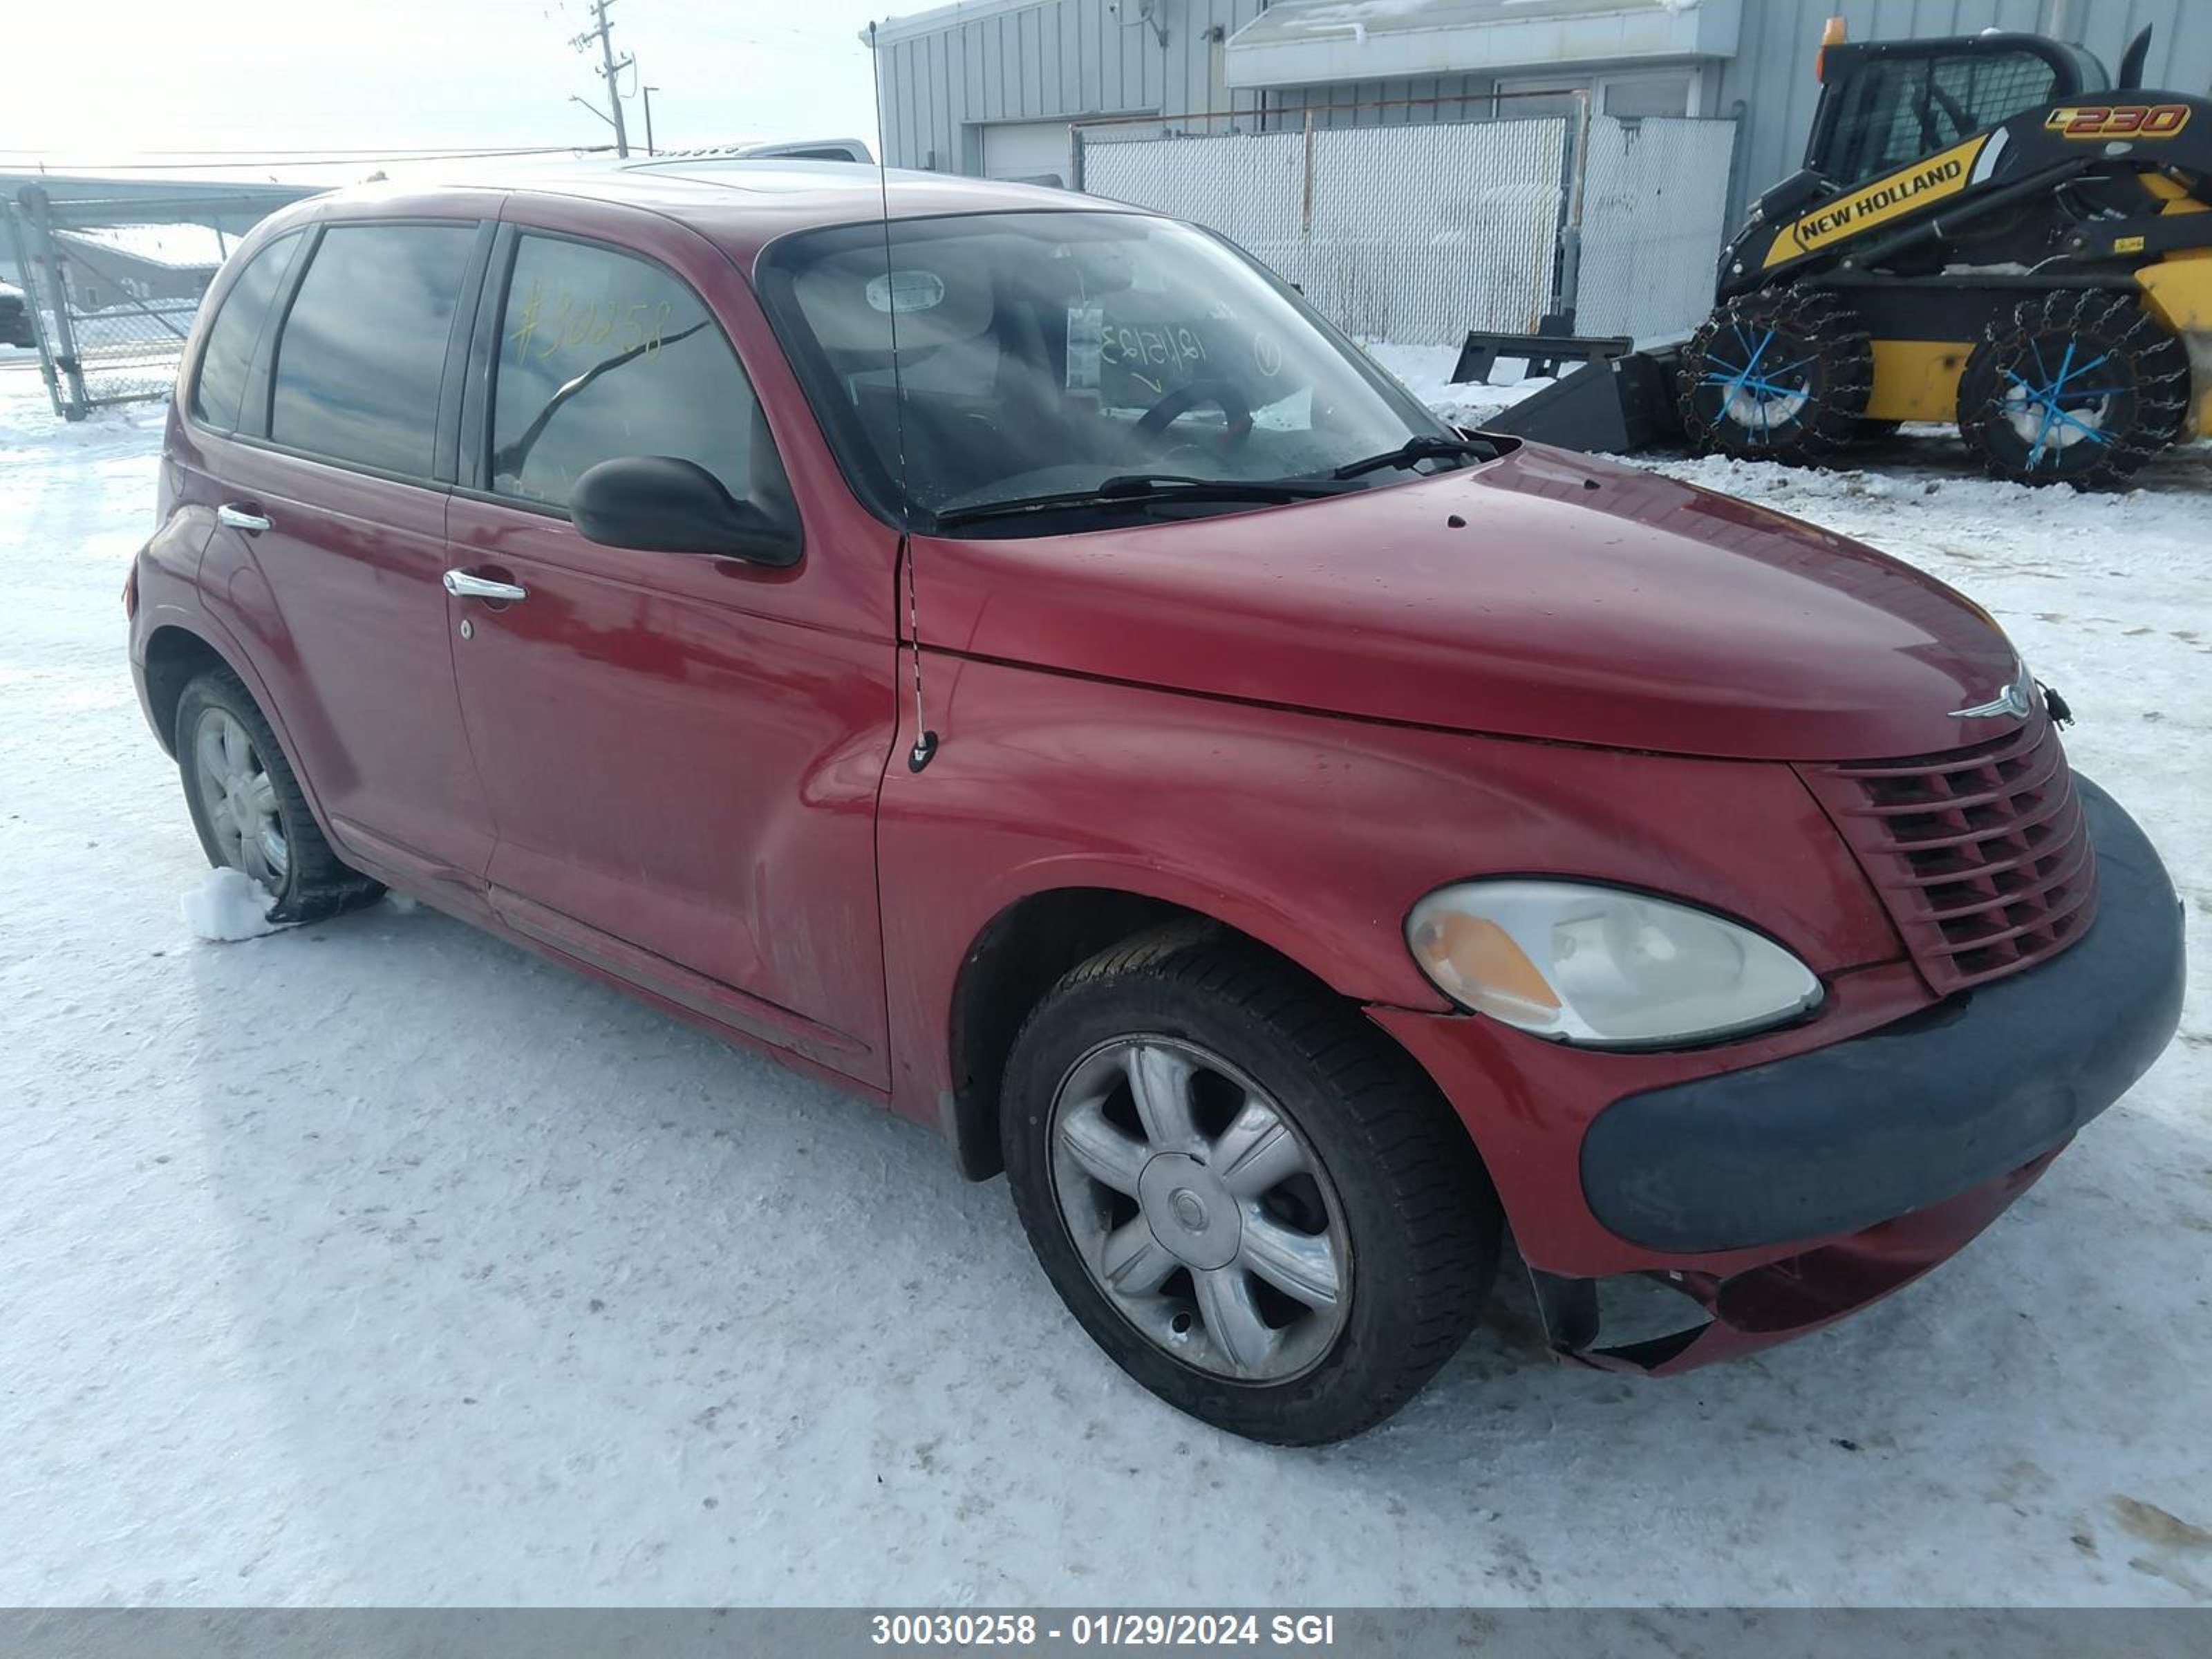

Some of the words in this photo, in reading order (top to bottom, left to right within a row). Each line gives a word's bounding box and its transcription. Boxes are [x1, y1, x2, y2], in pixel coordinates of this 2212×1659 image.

[2048, 105, 2190, 134] L230
[1801, 206, 1850, 241] NEW
[1855, 159, 1962, 218] HOLLAND
